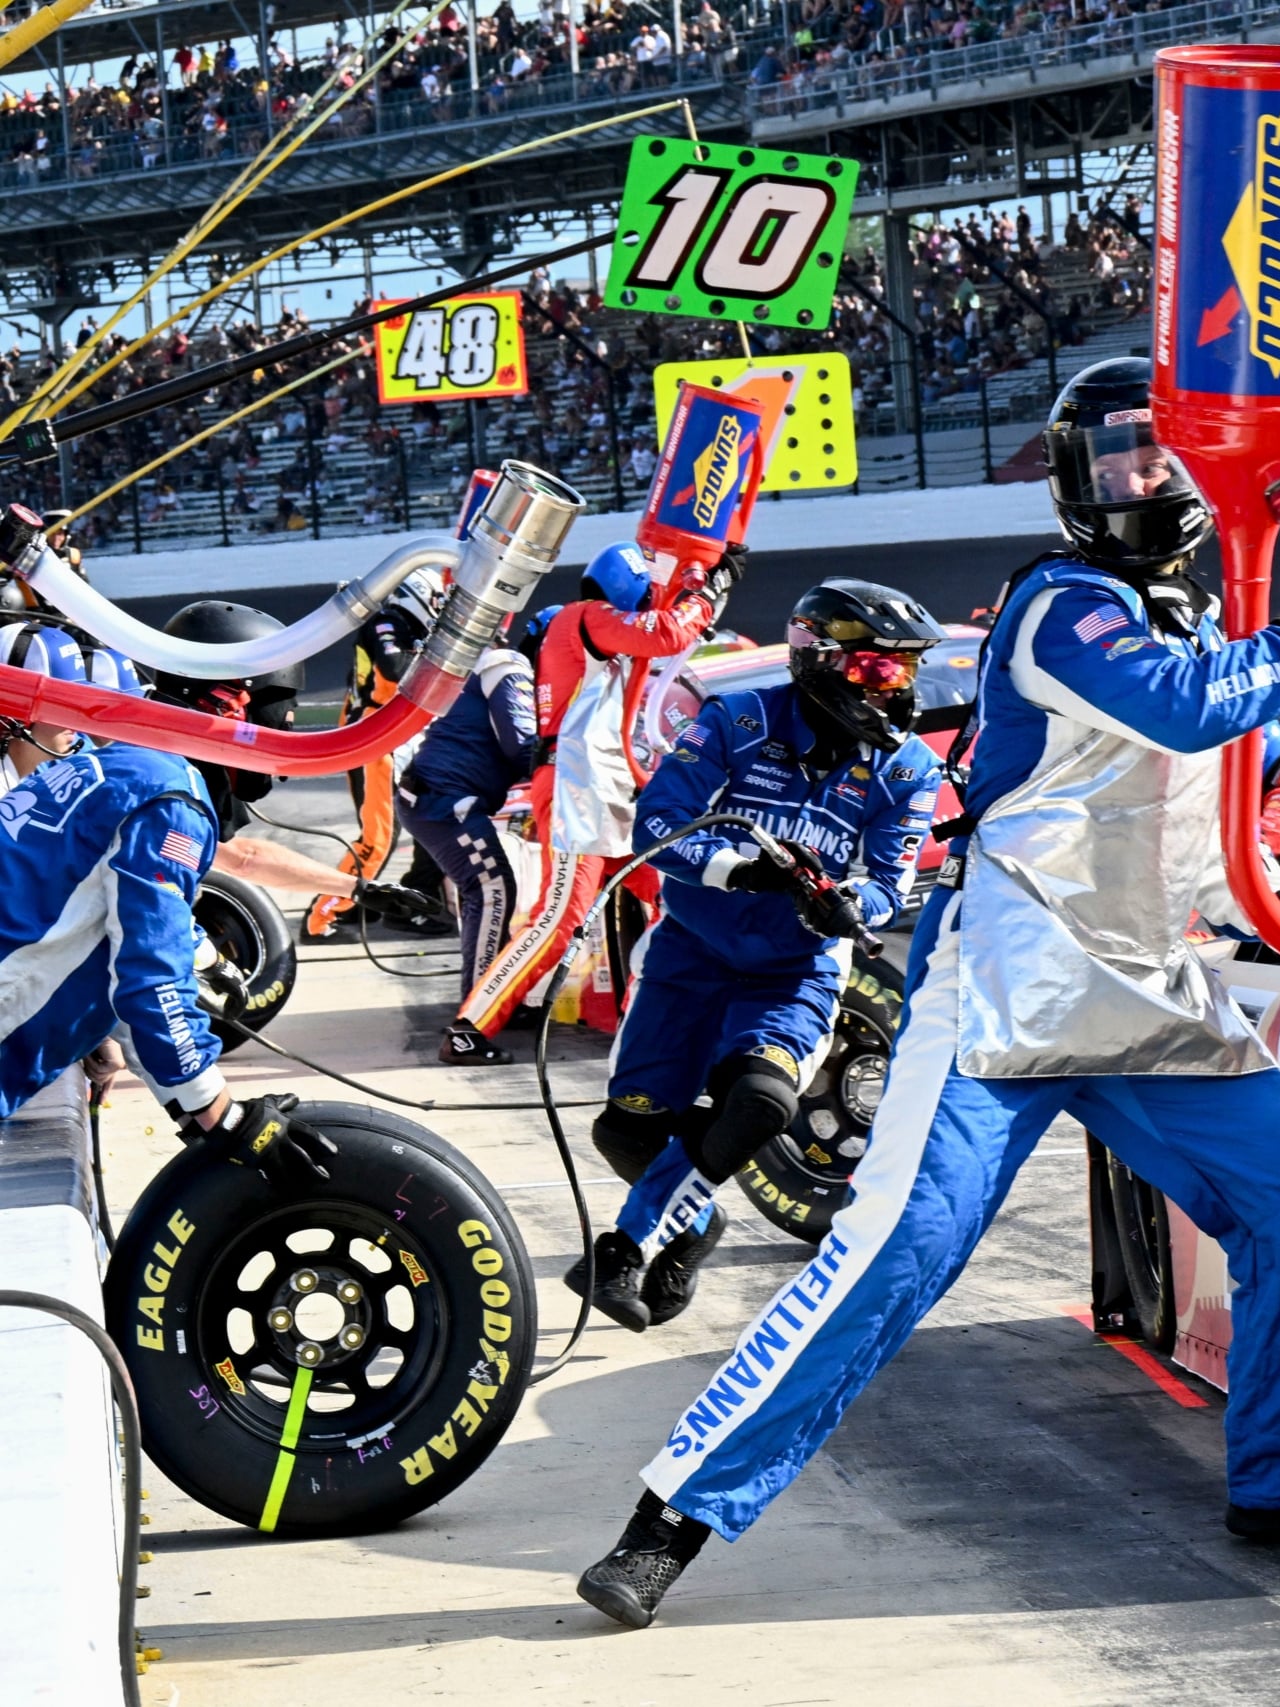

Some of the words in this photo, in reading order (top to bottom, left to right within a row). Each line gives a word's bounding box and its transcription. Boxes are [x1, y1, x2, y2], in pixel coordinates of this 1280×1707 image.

[1160, 109, 1180, 212] NASCAR
[625, 163, 836, 300] 10
[392, 303, 499, 390] 48
[696, 420, 738, 523] SUNOCO
[490, 889, 503, 927] KAULIG
[538, 853, 569, 929] CHAMPION
[483, 929, 541, 995] CONTAINER
[136, 1208, 196, 1351] EAGLE
[220, 1363, 243, 1393] AERO
[399, 1219, 512, 1486] GOODYEAR
[668, 1235, 848, 1459] HELLMANN'S
[662, 1508, 682, 1523] OMP
